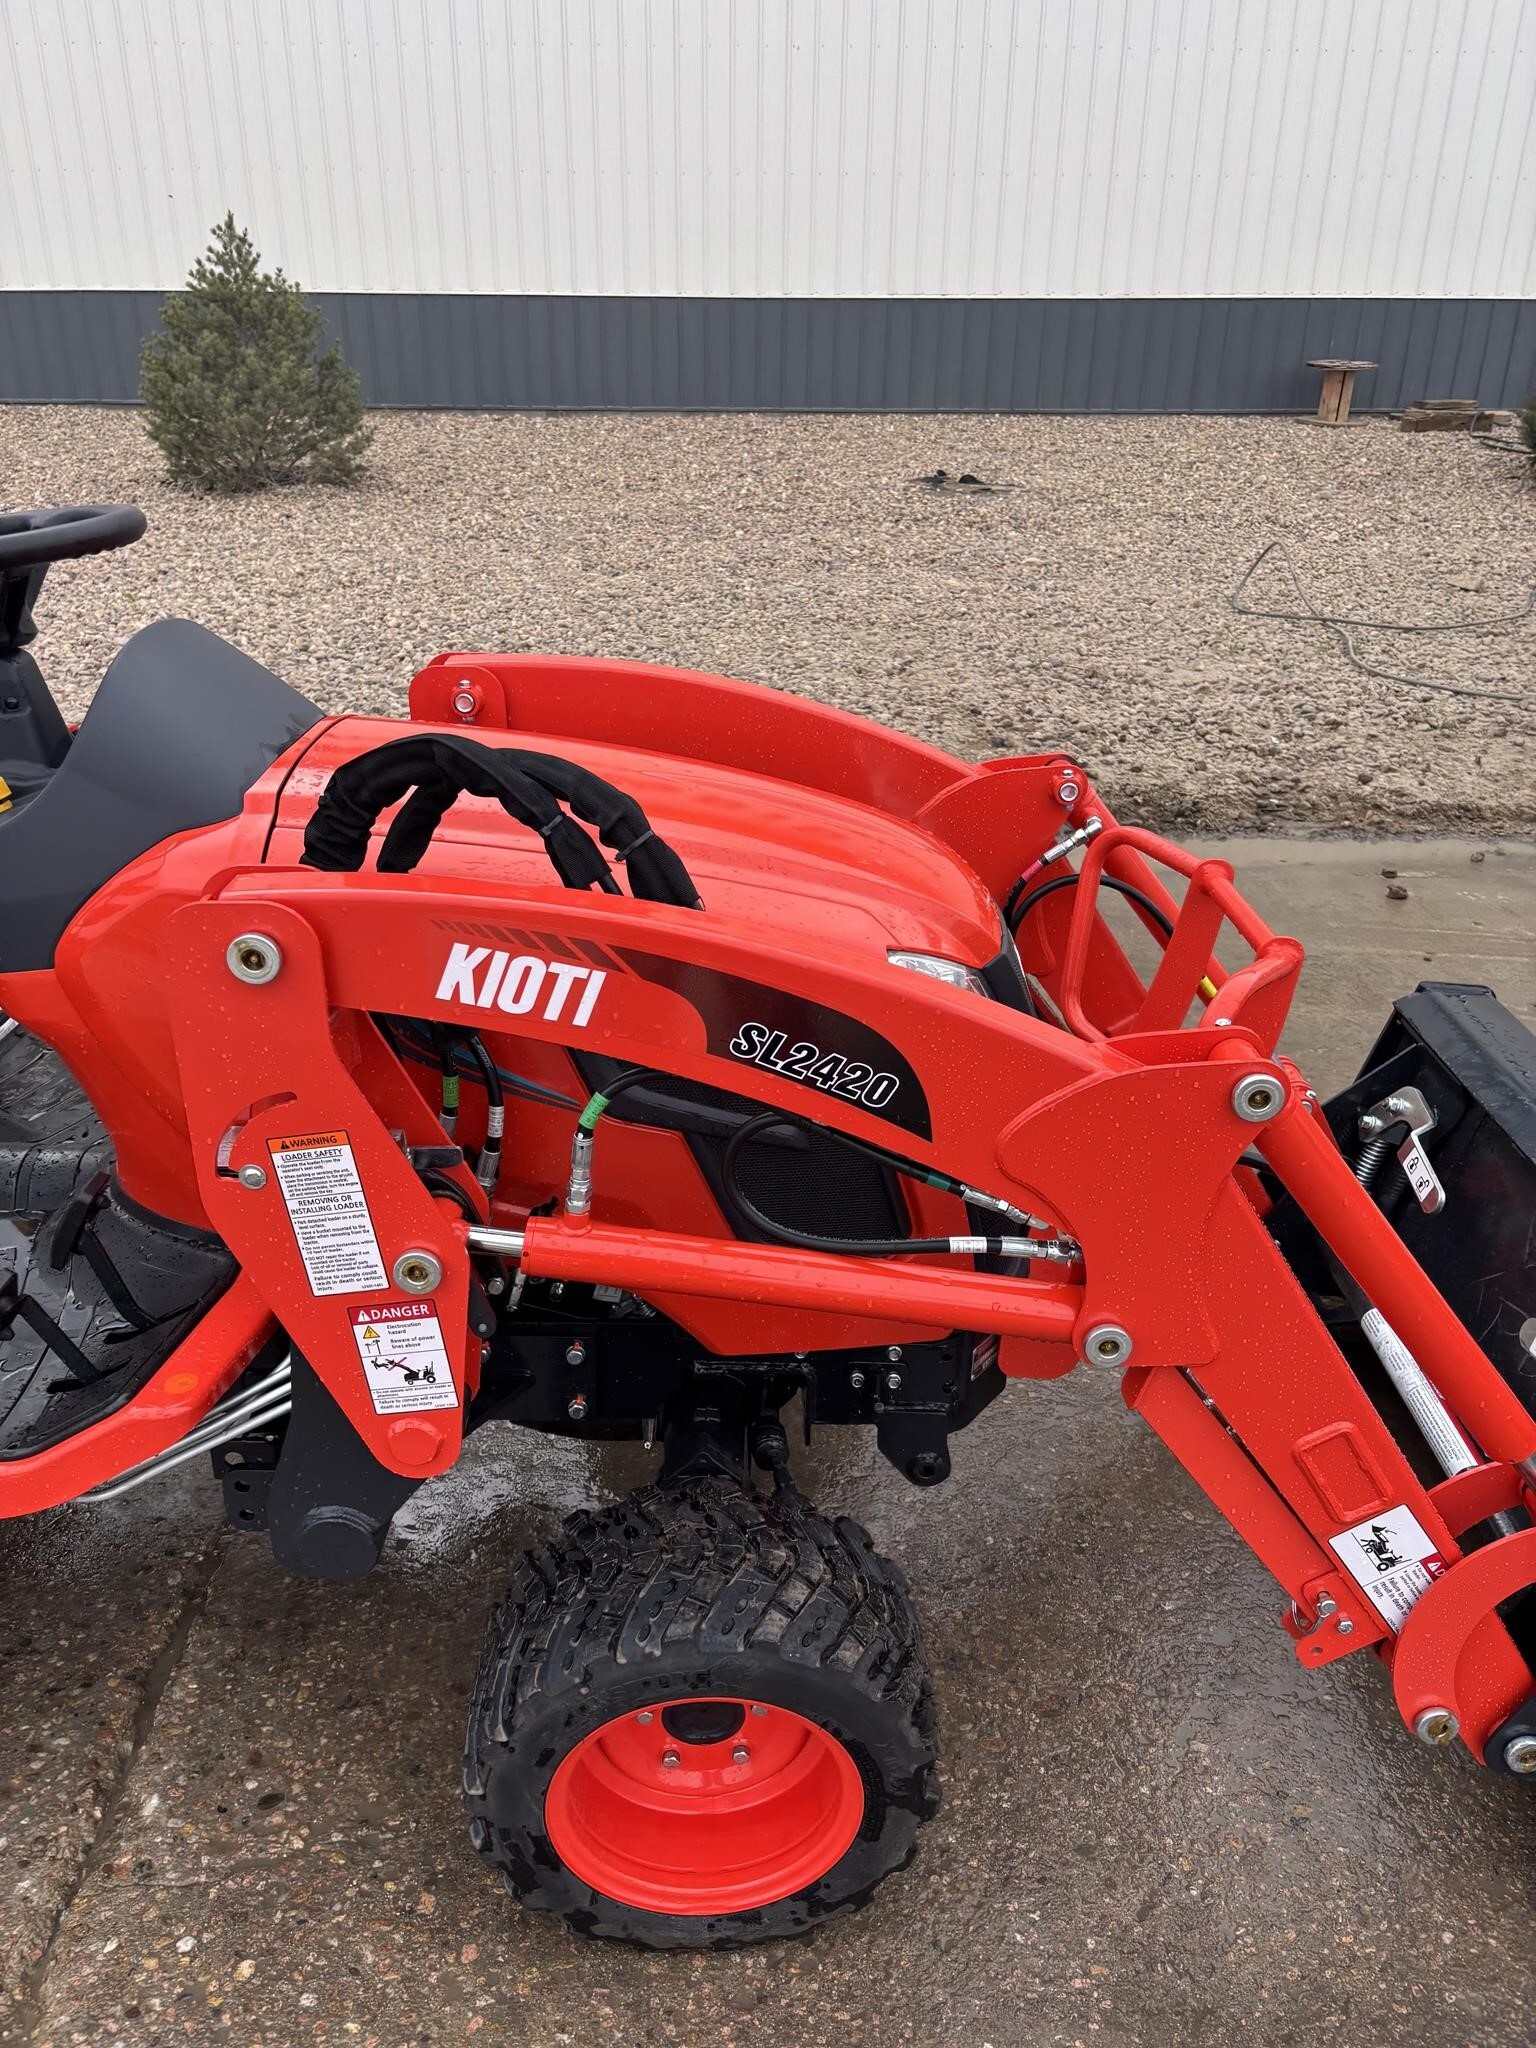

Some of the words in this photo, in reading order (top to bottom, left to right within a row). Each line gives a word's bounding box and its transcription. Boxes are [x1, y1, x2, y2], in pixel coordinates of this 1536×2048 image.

[435, 942, 607, 1027] KIOTI
[729, 1022, 900, 1108] SL2420
[289, 1135, 337, 1147] WARNING
[281, 1152, 312, 1161] LOADER
[314, 1148, 342, 1158] SAFETY
[291, 1205, 332, 1215] INSTALLING
[333, 1201, 364, 1210] LOADER
[298, 1196, 339, 1206] REMOVING
[371, 1305, 429, 1320] DANGER
[1372, 1584, 1384, 1599] injury.
[1388, 1577, 1401, 1592] Failure
[1380, 1581, 1392, 1594] result
[1392, 1598, 1404, 1611] death
